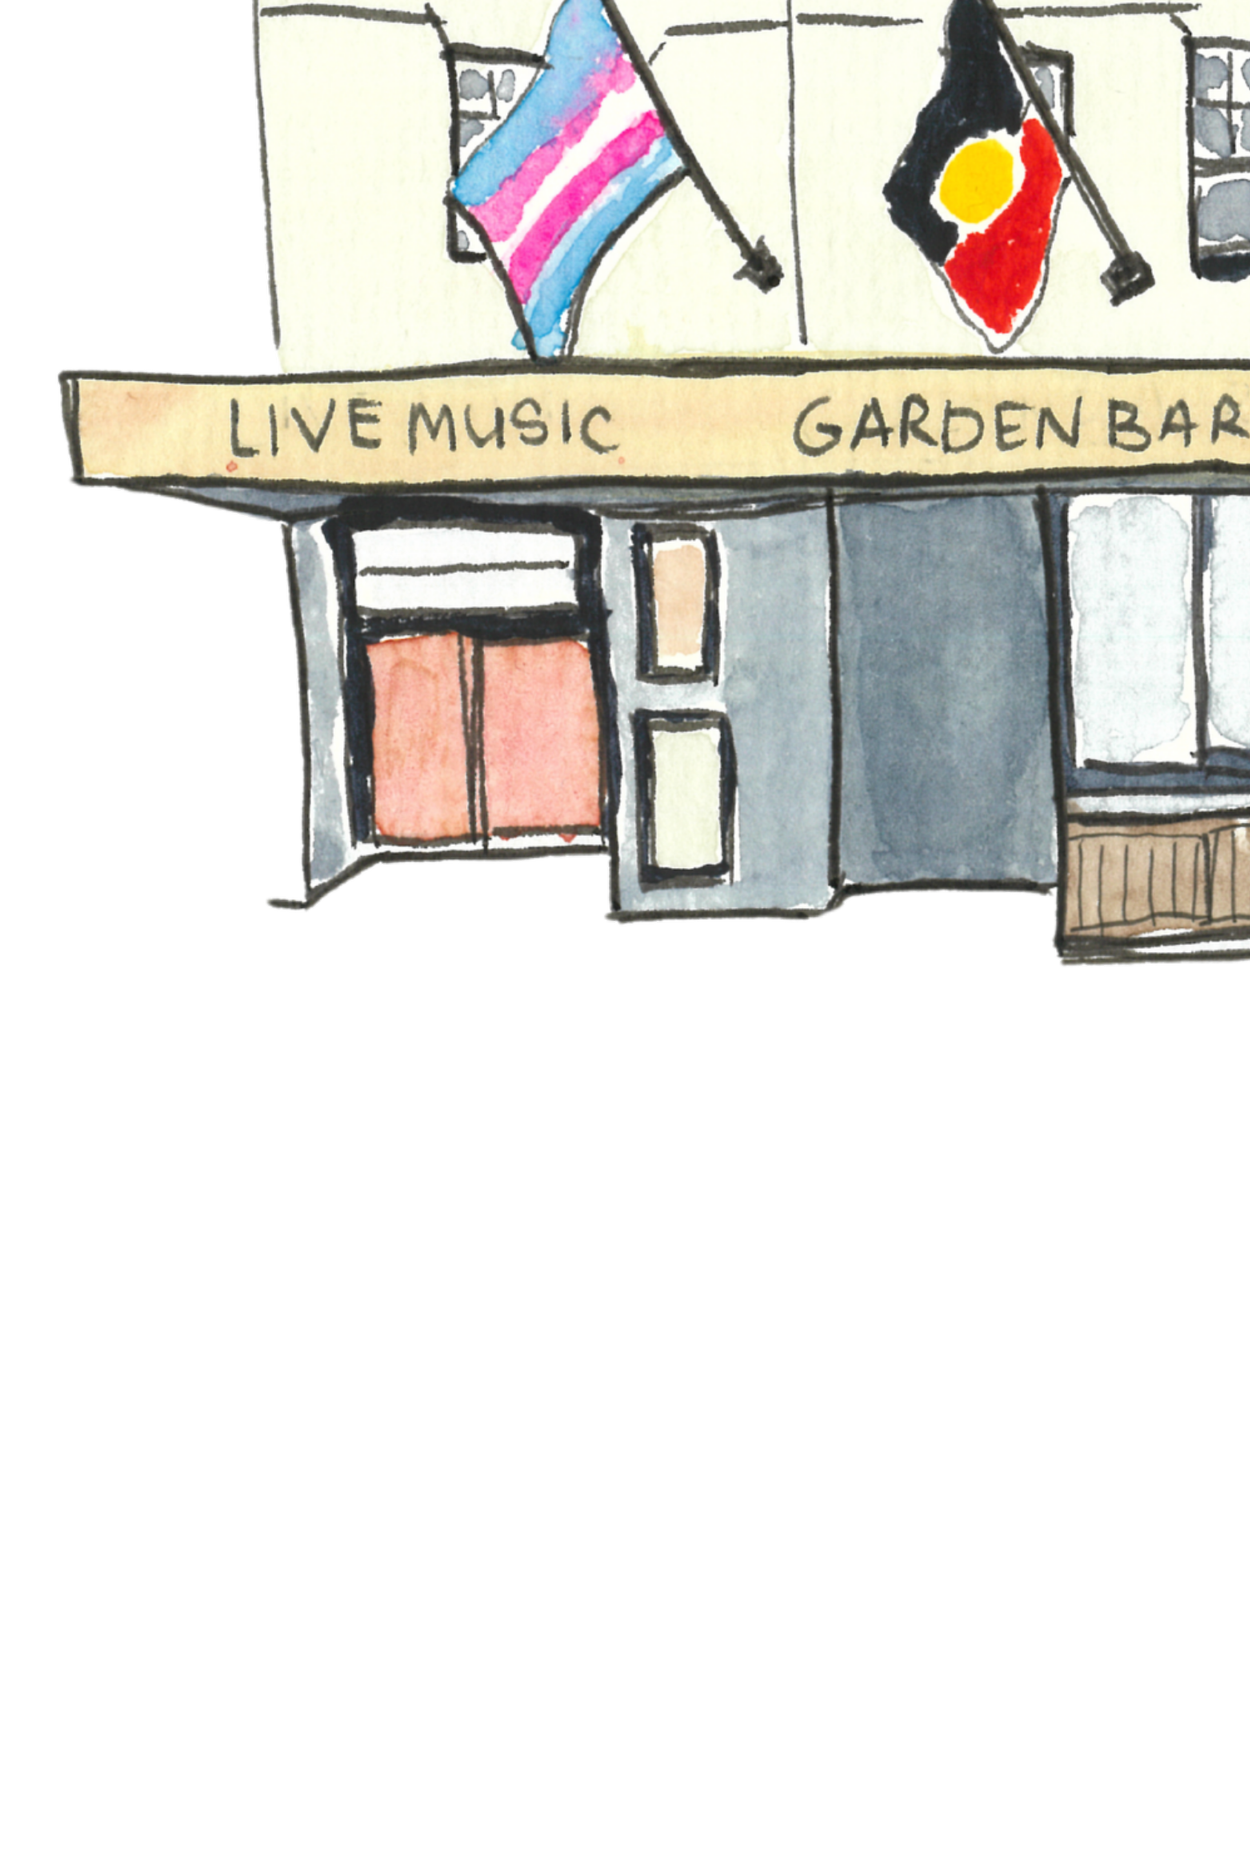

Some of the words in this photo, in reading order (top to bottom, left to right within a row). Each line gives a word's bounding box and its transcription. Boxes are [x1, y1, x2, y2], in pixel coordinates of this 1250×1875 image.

[229, 397, 382, 458] LIVE
[408, 396, 620, 455] MUSIC
[794, 392, 1083, 457] GARDEN
[1107, 392, 1250, 453] BAR
